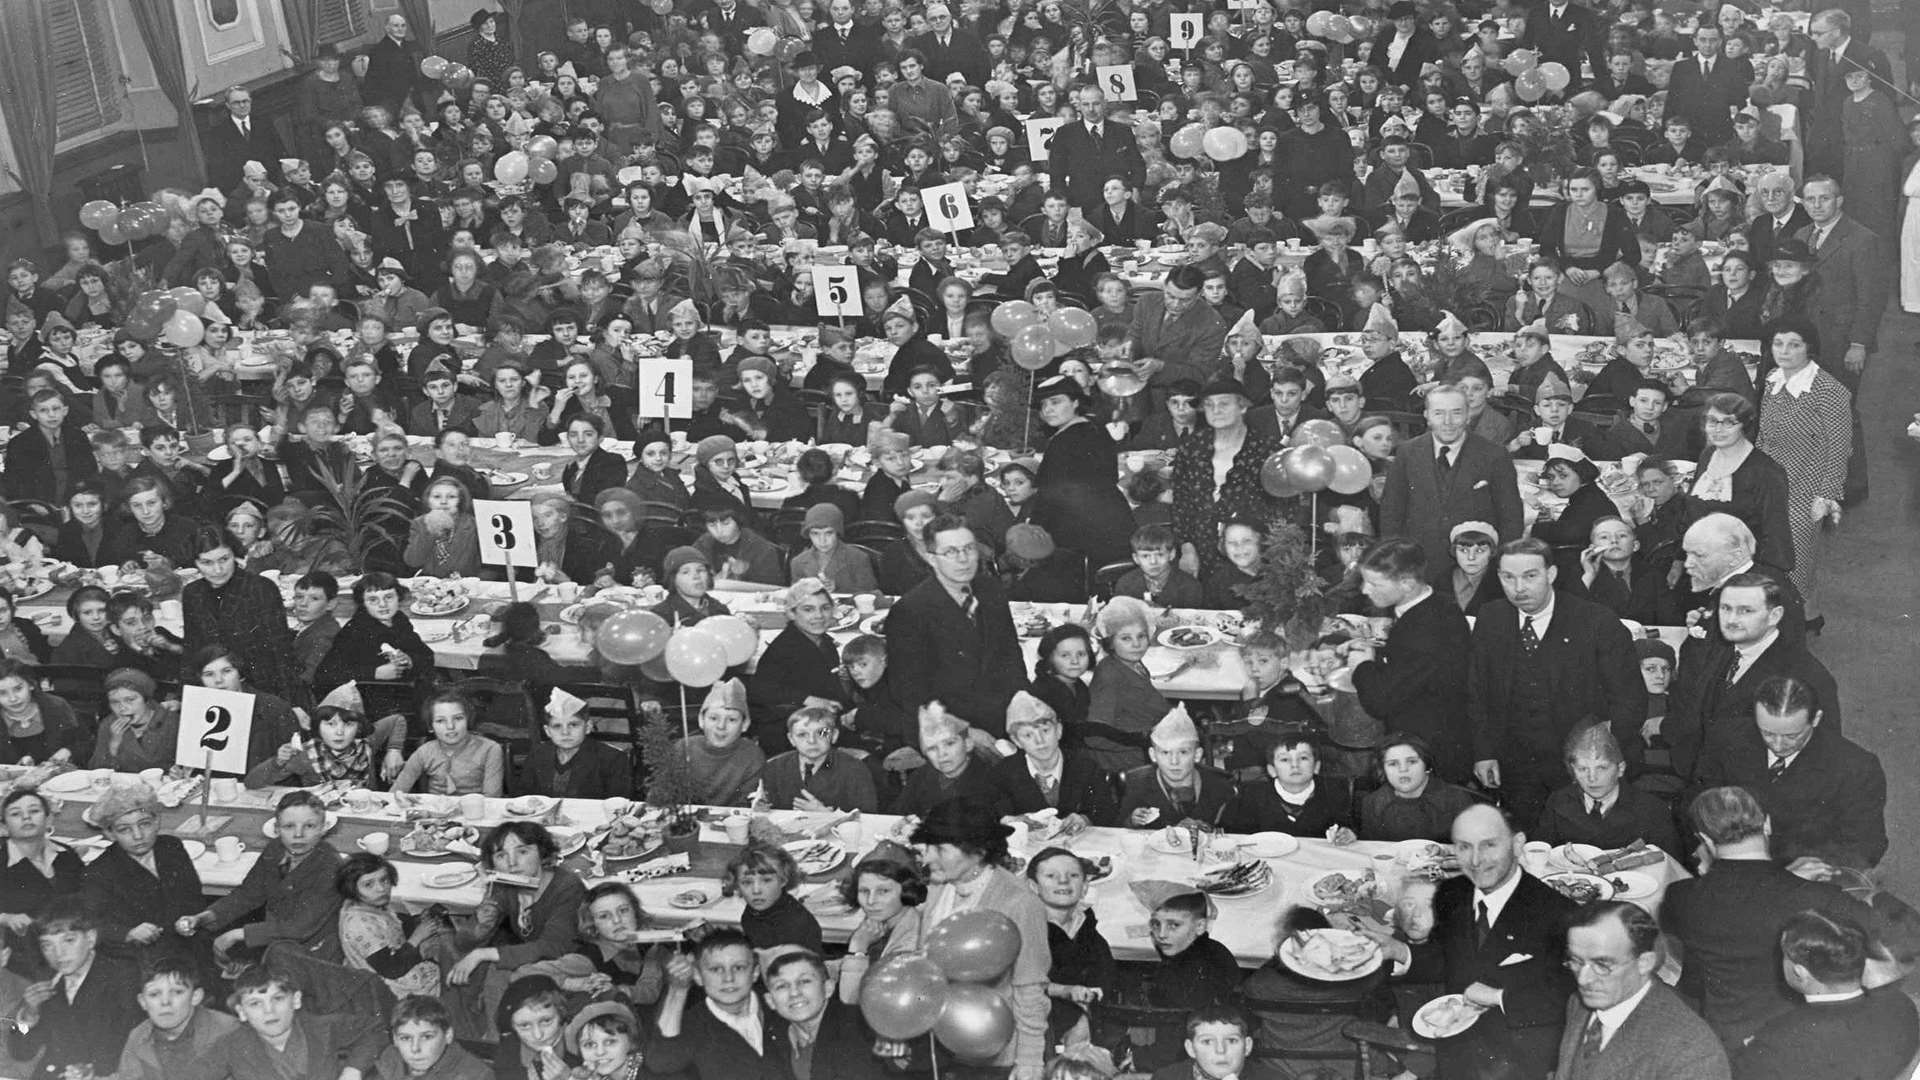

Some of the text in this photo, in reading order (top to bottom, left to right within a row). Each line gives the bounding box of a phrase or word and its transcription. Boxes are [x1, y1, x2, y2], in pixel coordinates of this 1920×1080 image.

[1181, 19, 1195, 41] 9
[1109, 73, 1126, 95] 8
[1040, 127, 1055, 150] 7
[939, 193, 959, 219] 6
[828, 276, 848, 305] 5
[655, 371, 676, 404] 4
[491, 514, 516, 550] 3
[199, 705, 232, 752] 2
